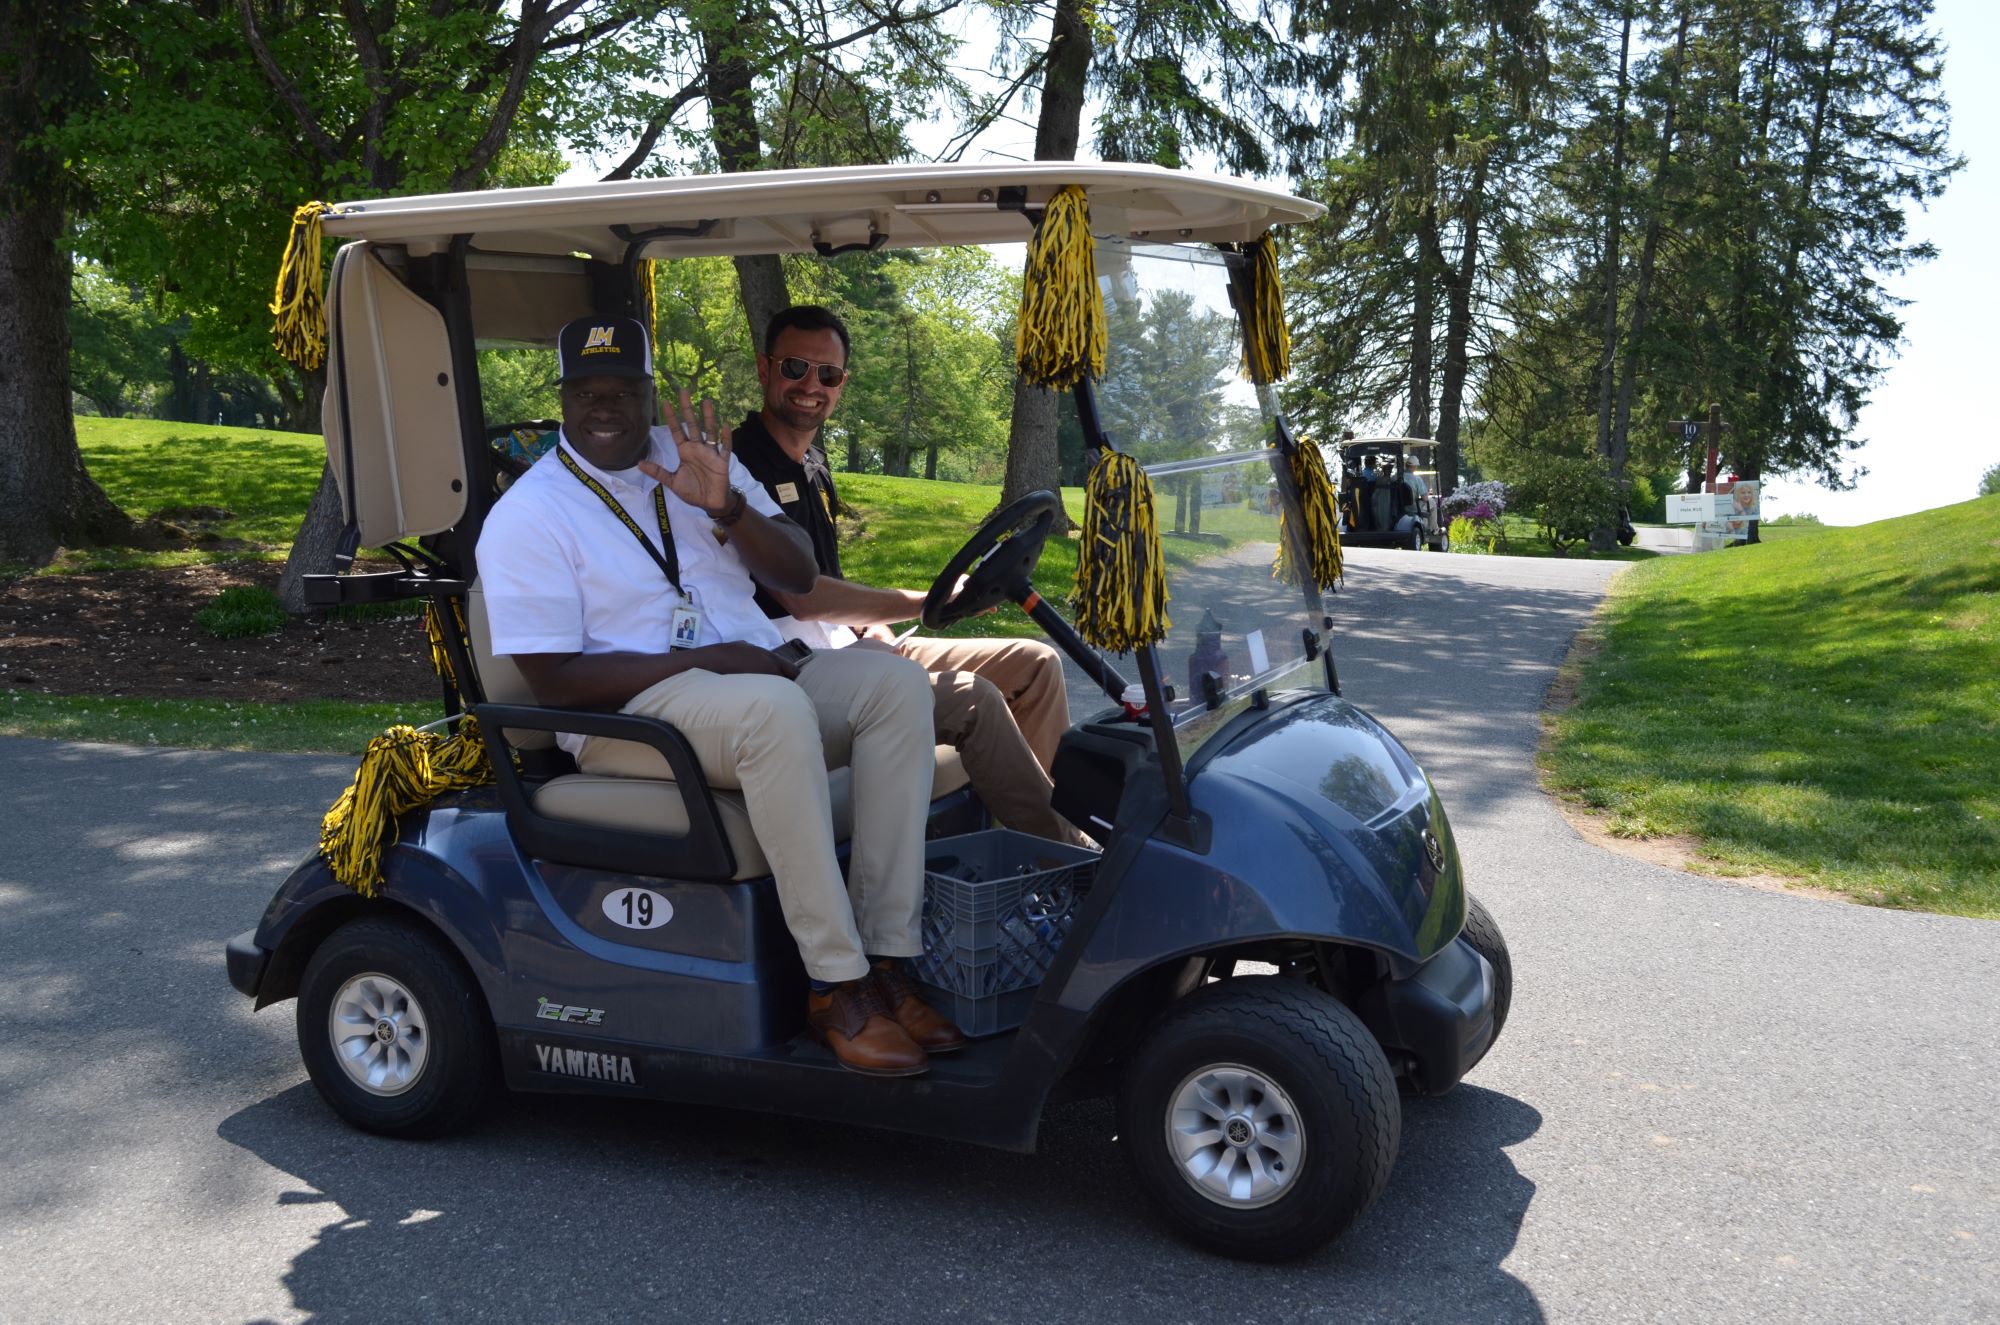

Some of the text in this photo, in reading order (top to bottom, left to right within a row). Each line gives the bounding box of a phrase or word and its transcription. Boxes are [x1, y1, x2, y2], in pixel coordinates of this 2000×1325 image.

[584, 326, 615, 348] LM
[580, 346, 621, 356] ATHLETICS
[1685, 423, 1697, 435] 10
[559, 451, 644, 540] LANCASTER MENNONITE SCHOOL
[621, 891, 654, 927] 19
[536, 1001, 606, 1022] EFI
[535, 1044, 637, 1084] YAMAHA
